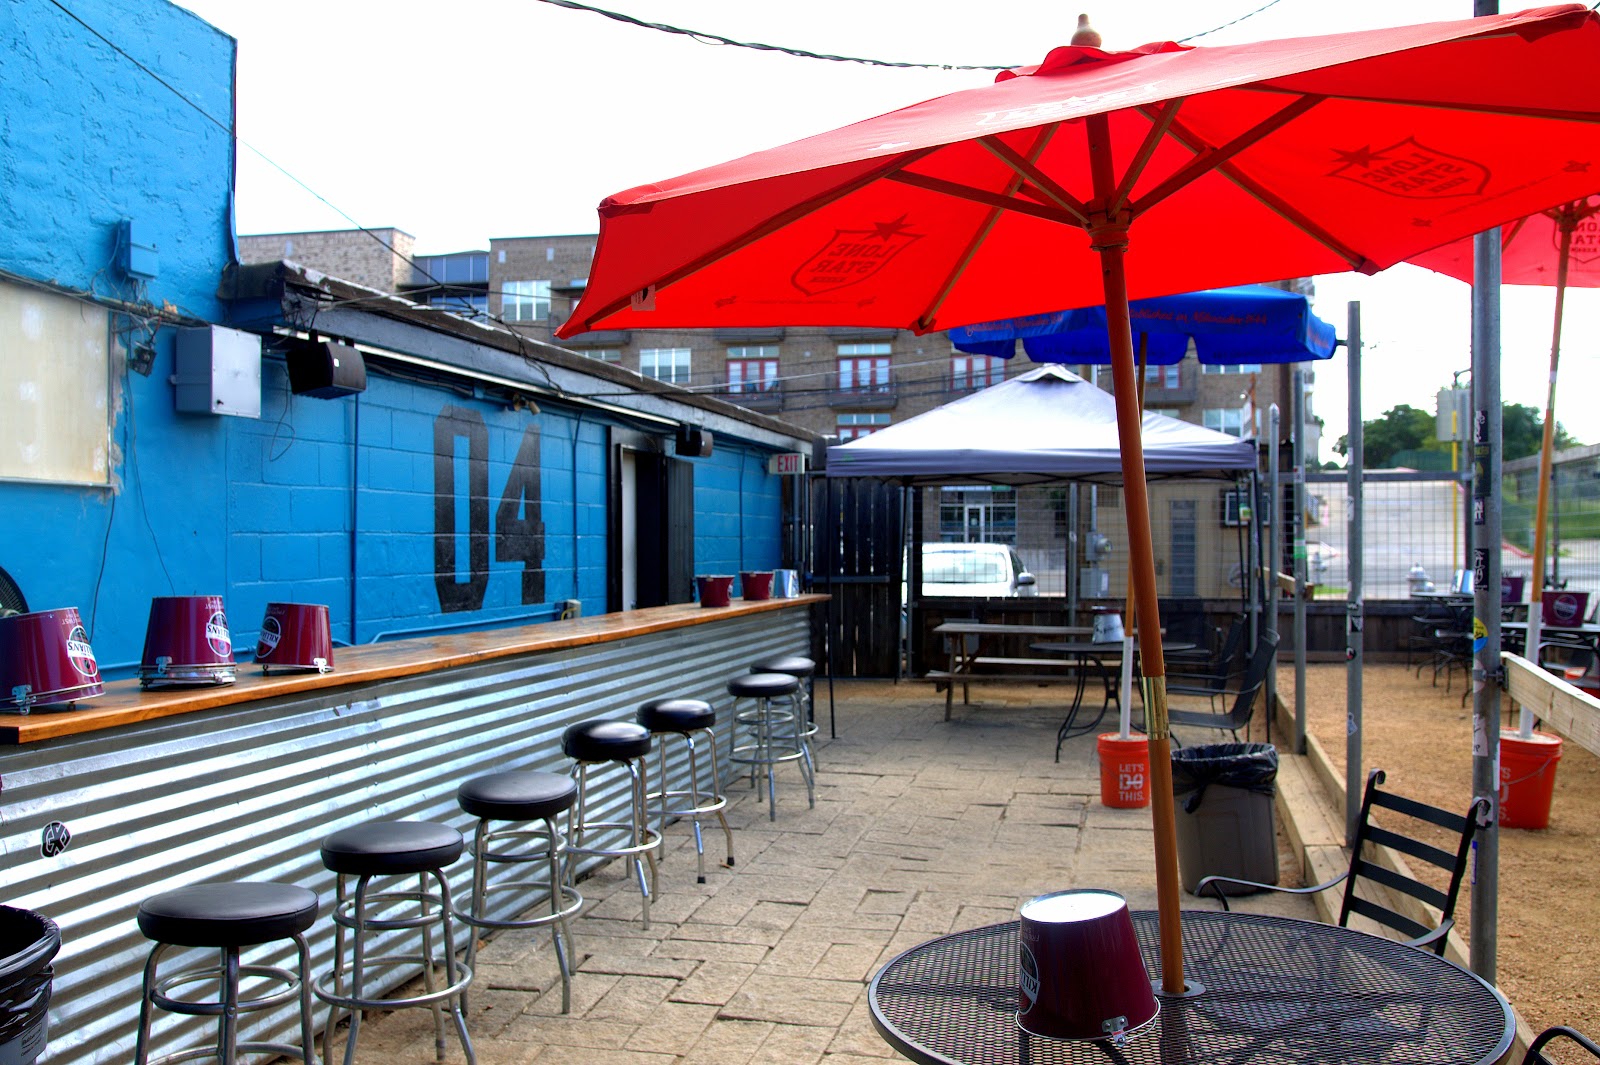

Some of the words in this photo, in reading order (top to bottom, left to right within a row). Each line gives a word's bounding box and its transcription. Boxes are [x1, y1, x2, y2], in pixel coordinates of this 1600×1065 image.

[777, 455, 799, 472] EXIT
[434, 405, 545, 613] 04
[1119, 763, 1144, 772] LET'S
[1119, 773, 1144, 790] DO
